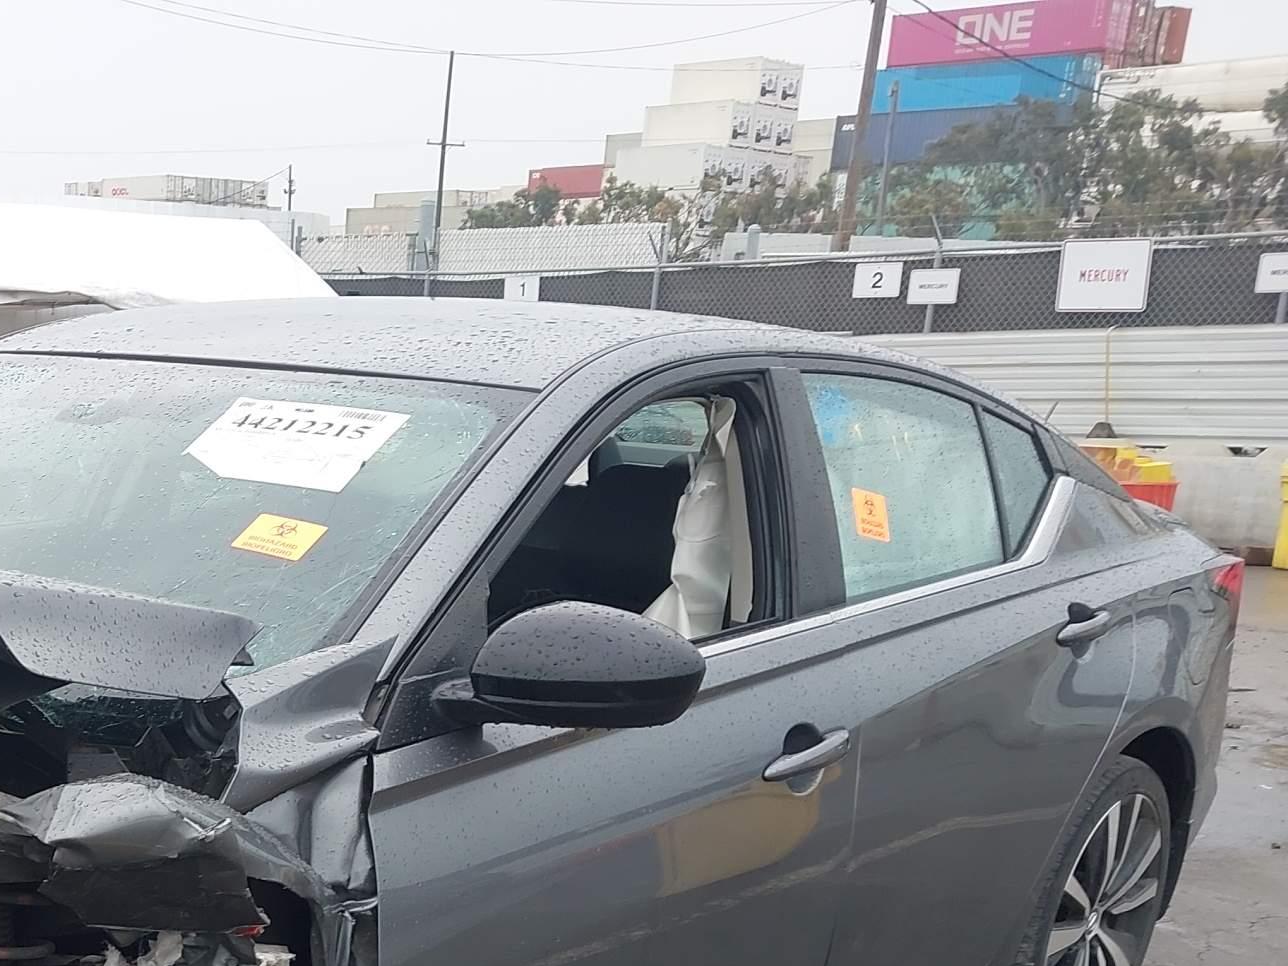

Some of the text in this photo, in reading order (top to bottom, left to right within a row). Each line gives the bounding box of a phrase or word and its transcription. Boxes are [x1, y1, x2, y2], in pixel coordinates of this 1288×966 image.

[957, 9, 1035, 44] ONE
[871, 272, 884, 289] 2
[1078, 269, 1130, 282] MERCURY
[520, 281, 526, 296] 1
[233, 414, 372, 439] 44212215
